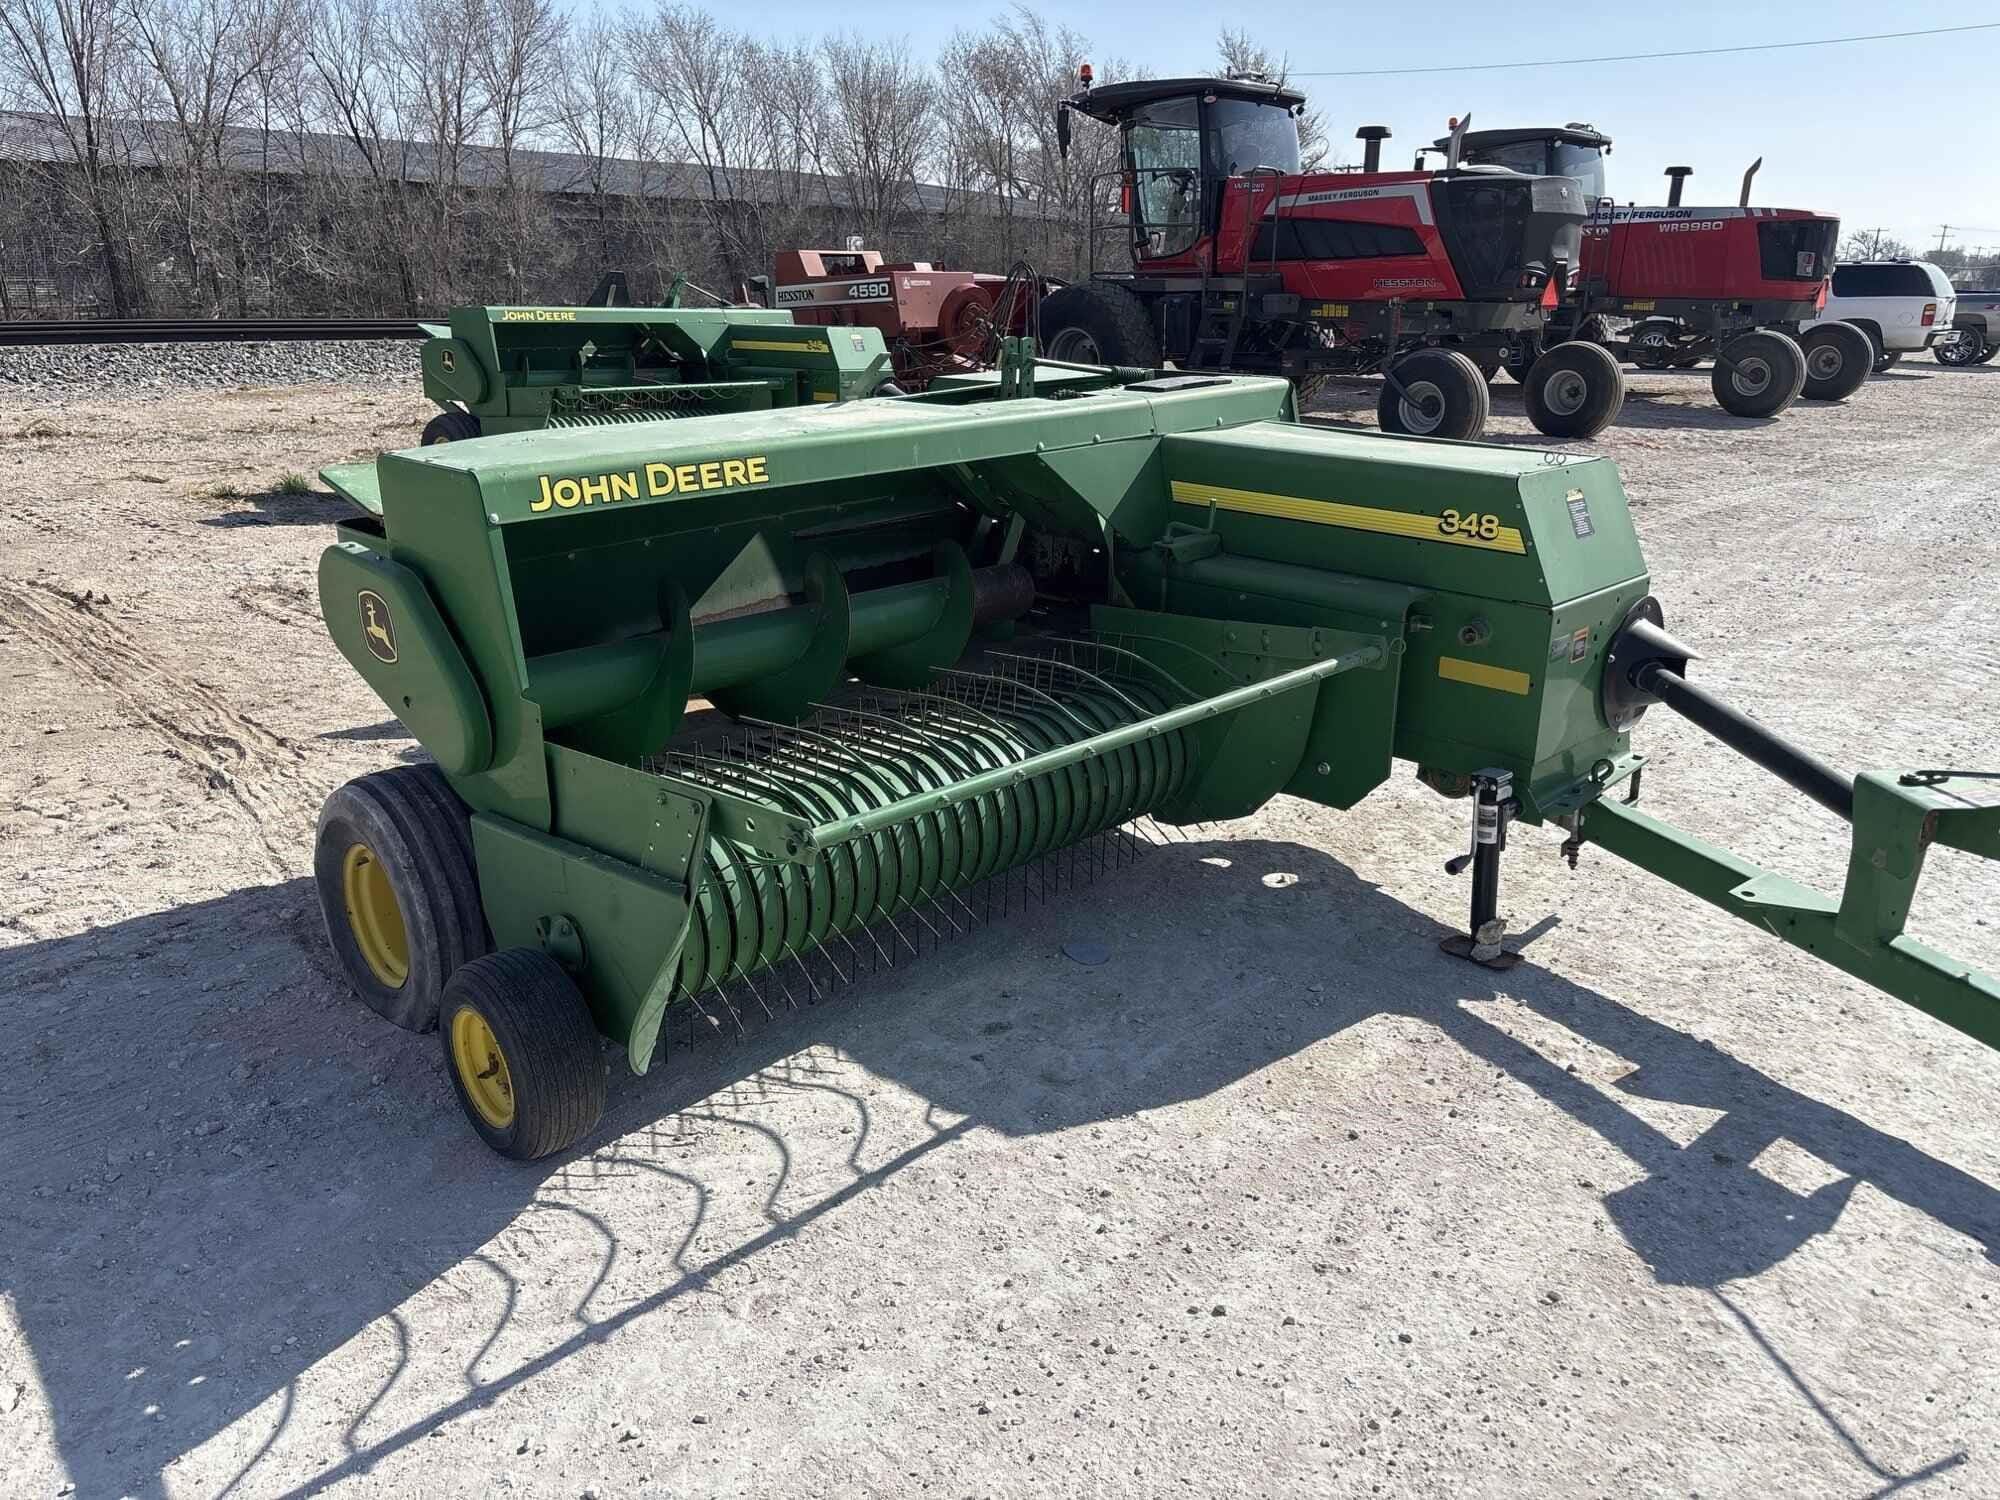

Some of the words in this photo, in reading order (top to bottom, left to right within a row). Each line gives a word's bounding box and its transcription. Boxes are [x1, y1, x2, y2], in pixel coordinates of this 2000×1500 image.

[1308, 192, 1338, 201] MASSEY
[1339, 188, 1379, 199] FERGUSON
[1631, 209, 1693, 219] FERGUSON
[1658, 221, 1724, 233] WR9980
[1373, 278, 1437, 288] HESSTON
[777, 289, 815, 303] HESSTON
[849, 283, 889, 298] 4590
[502, 310, 535, 320] JOHN
[536, 310, 576, 320] DEERE
[530, 472, 640, 513] JOHN
[643, 456, 770, 498] DEERE
[1438, 509, 1500, 540] 348
